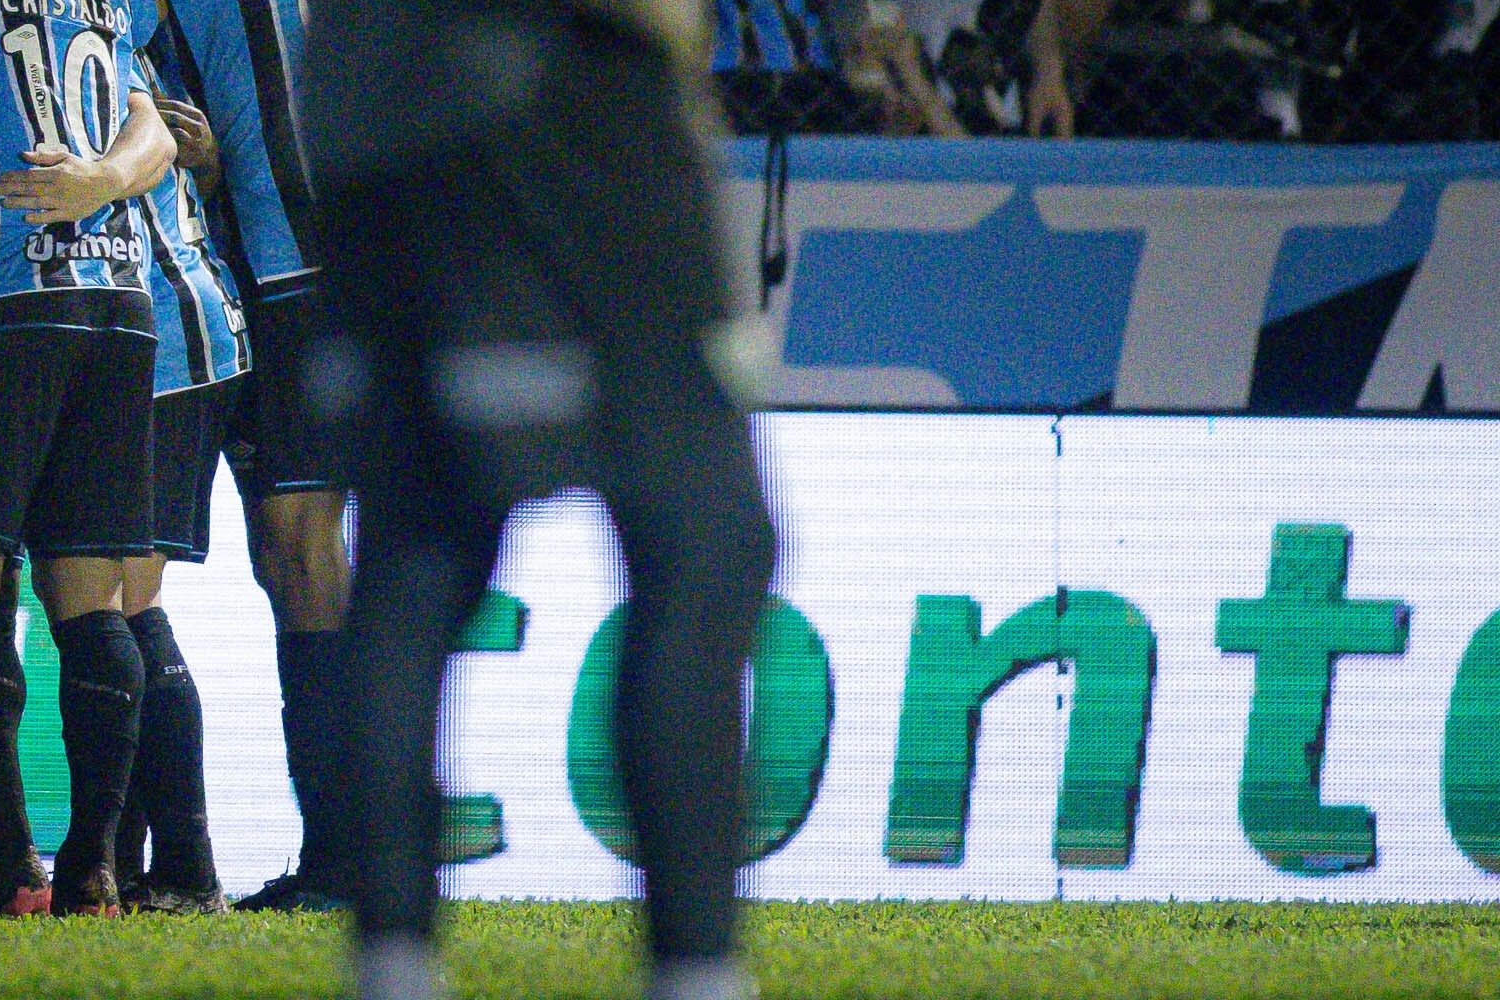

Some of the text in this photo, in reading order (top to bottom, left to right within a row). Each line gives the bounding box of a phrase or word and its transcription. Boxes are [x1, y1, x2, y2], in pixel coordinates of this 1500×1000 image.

[2, 23, 119, 162] 10
[27, 233, 143, 262] Unimed
[445, 522, 1500, 880] ont
